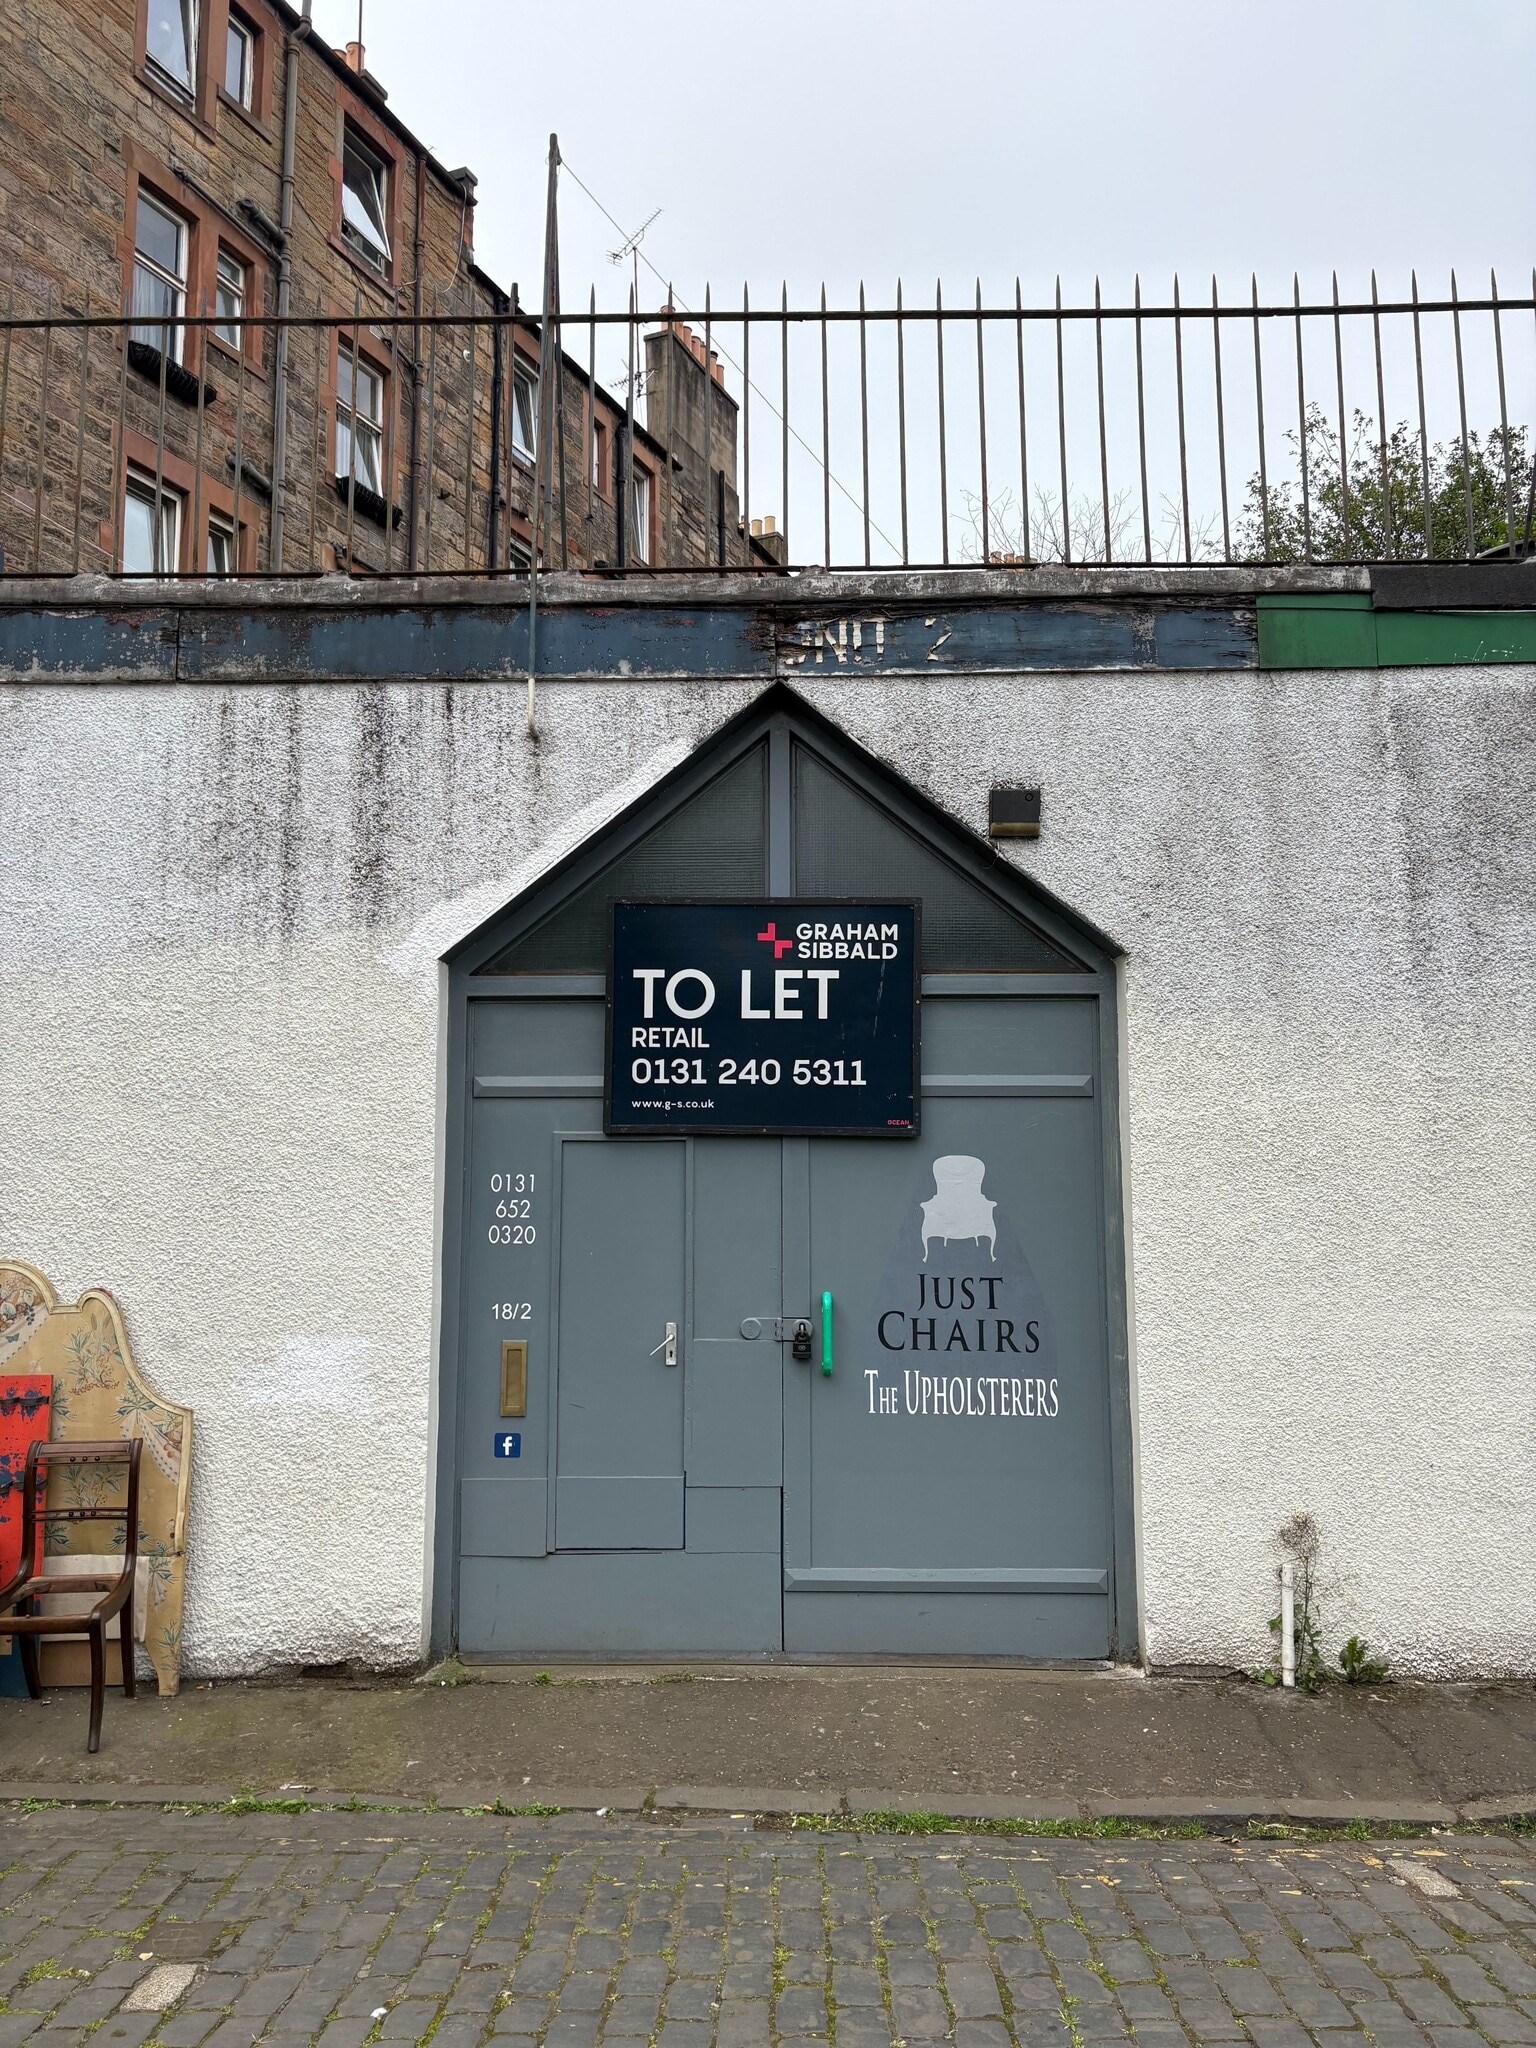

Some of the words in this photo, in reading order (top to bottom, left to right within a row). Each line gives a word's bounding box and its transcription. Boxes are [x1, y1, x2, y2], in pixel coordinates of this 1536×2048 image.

[784, 615, 895, 665] NIT
[796, 923, 899, 941] GRAHAM
[797, 942, 898, 960] SIBBALD
[633, 968, 716, 1020] TO
[741, 969, 840, 1020] LET
[631, 1027, 710, 1048] RETAIL
[631, 1058, 707, 1085] 0131
[718, 1058, 781, 1085] 240
[792, 1059, 867, 1086] 5311
[631, 1099, 715, 1110] www.g-s.co.uk
[490, 1173, 536, 1193] 0131
[495, 1199, 531, 1218] 652
[488, 1225, 537, 1244] 0320
[918, 1274, 1003, 1311] JUST
[491, 1302, 532, 1320] 18/2
[877, 1310, 1040, 1354] CHAIRS
[864, 1369, 898, 1414] THE
[904, 1370, 1059, 1417] UPHOLSTERERS
